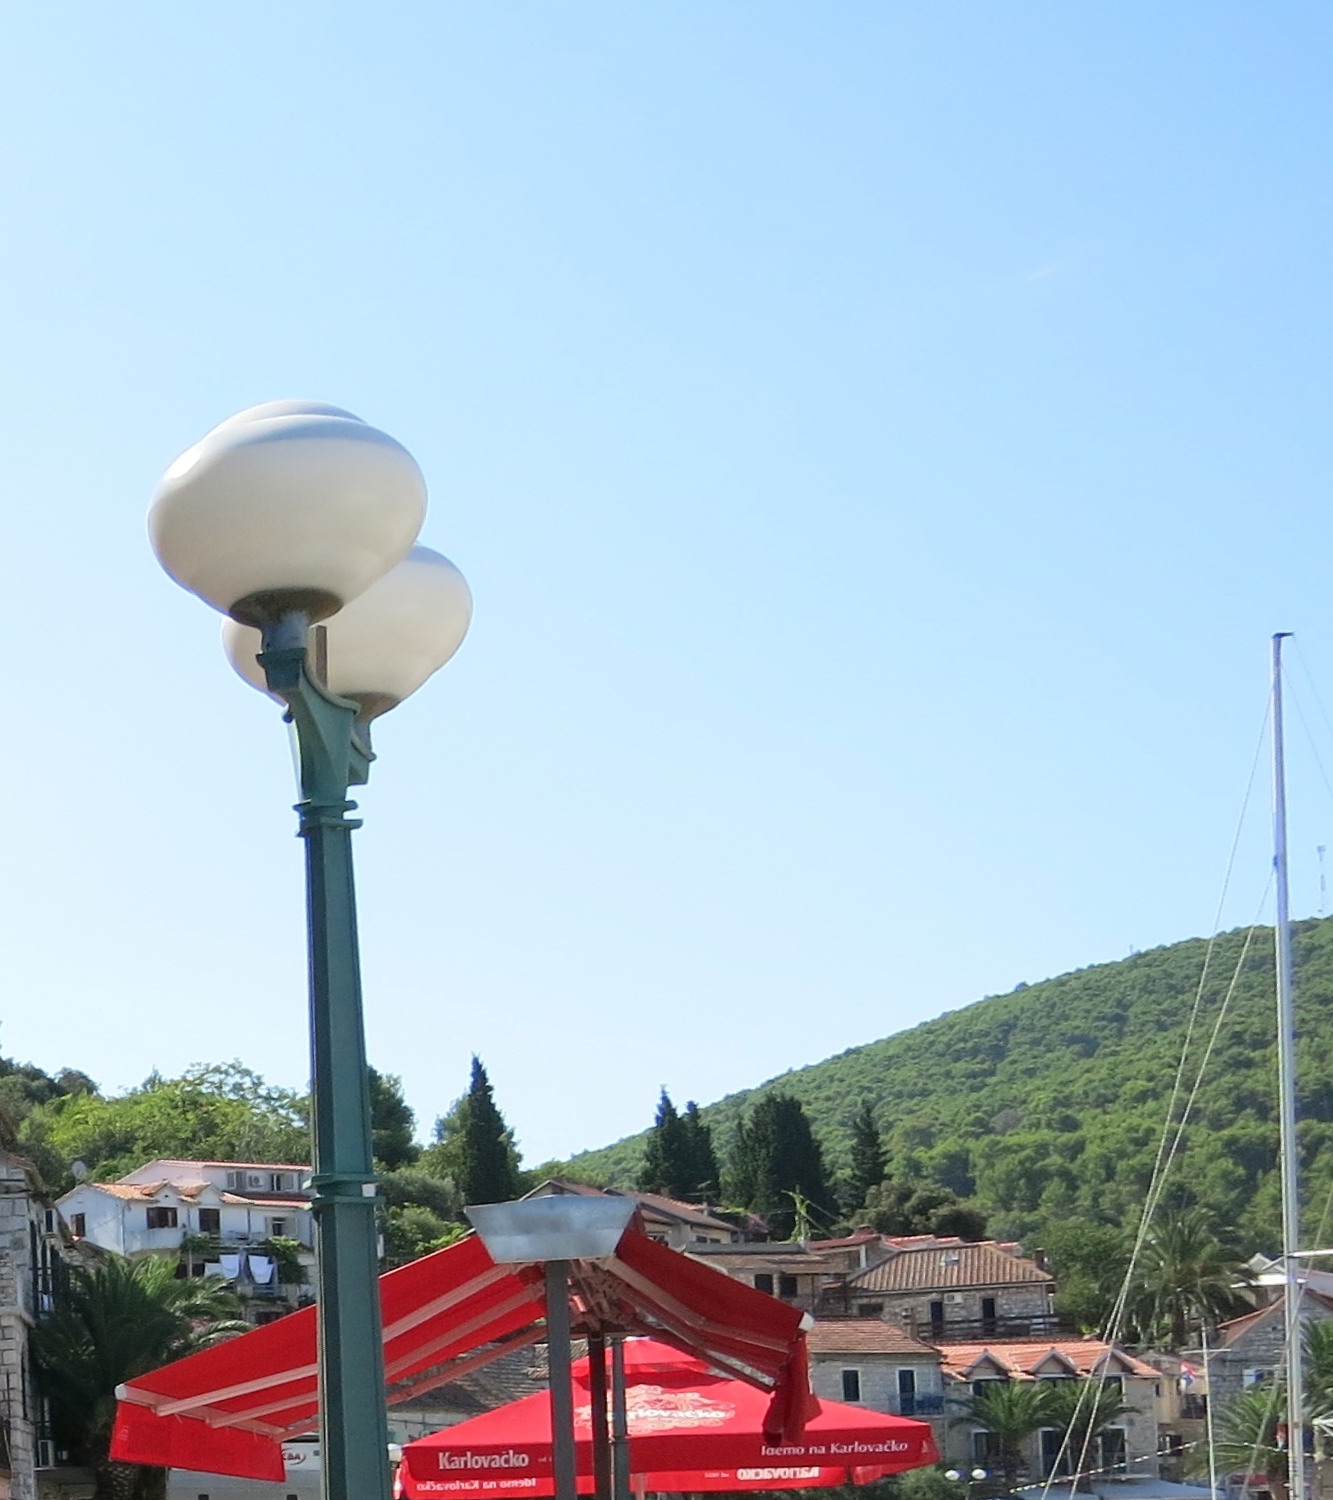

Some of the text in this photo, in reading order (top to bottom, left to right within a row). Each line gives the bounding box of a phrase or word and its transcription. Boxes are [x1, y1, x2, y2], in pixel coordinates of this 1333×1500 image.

[809, 1445, 826, 1455] na
[830, 1439, 909, 1454] Karlovačko
[438, 1449, 530, 1470] Karlovačko
